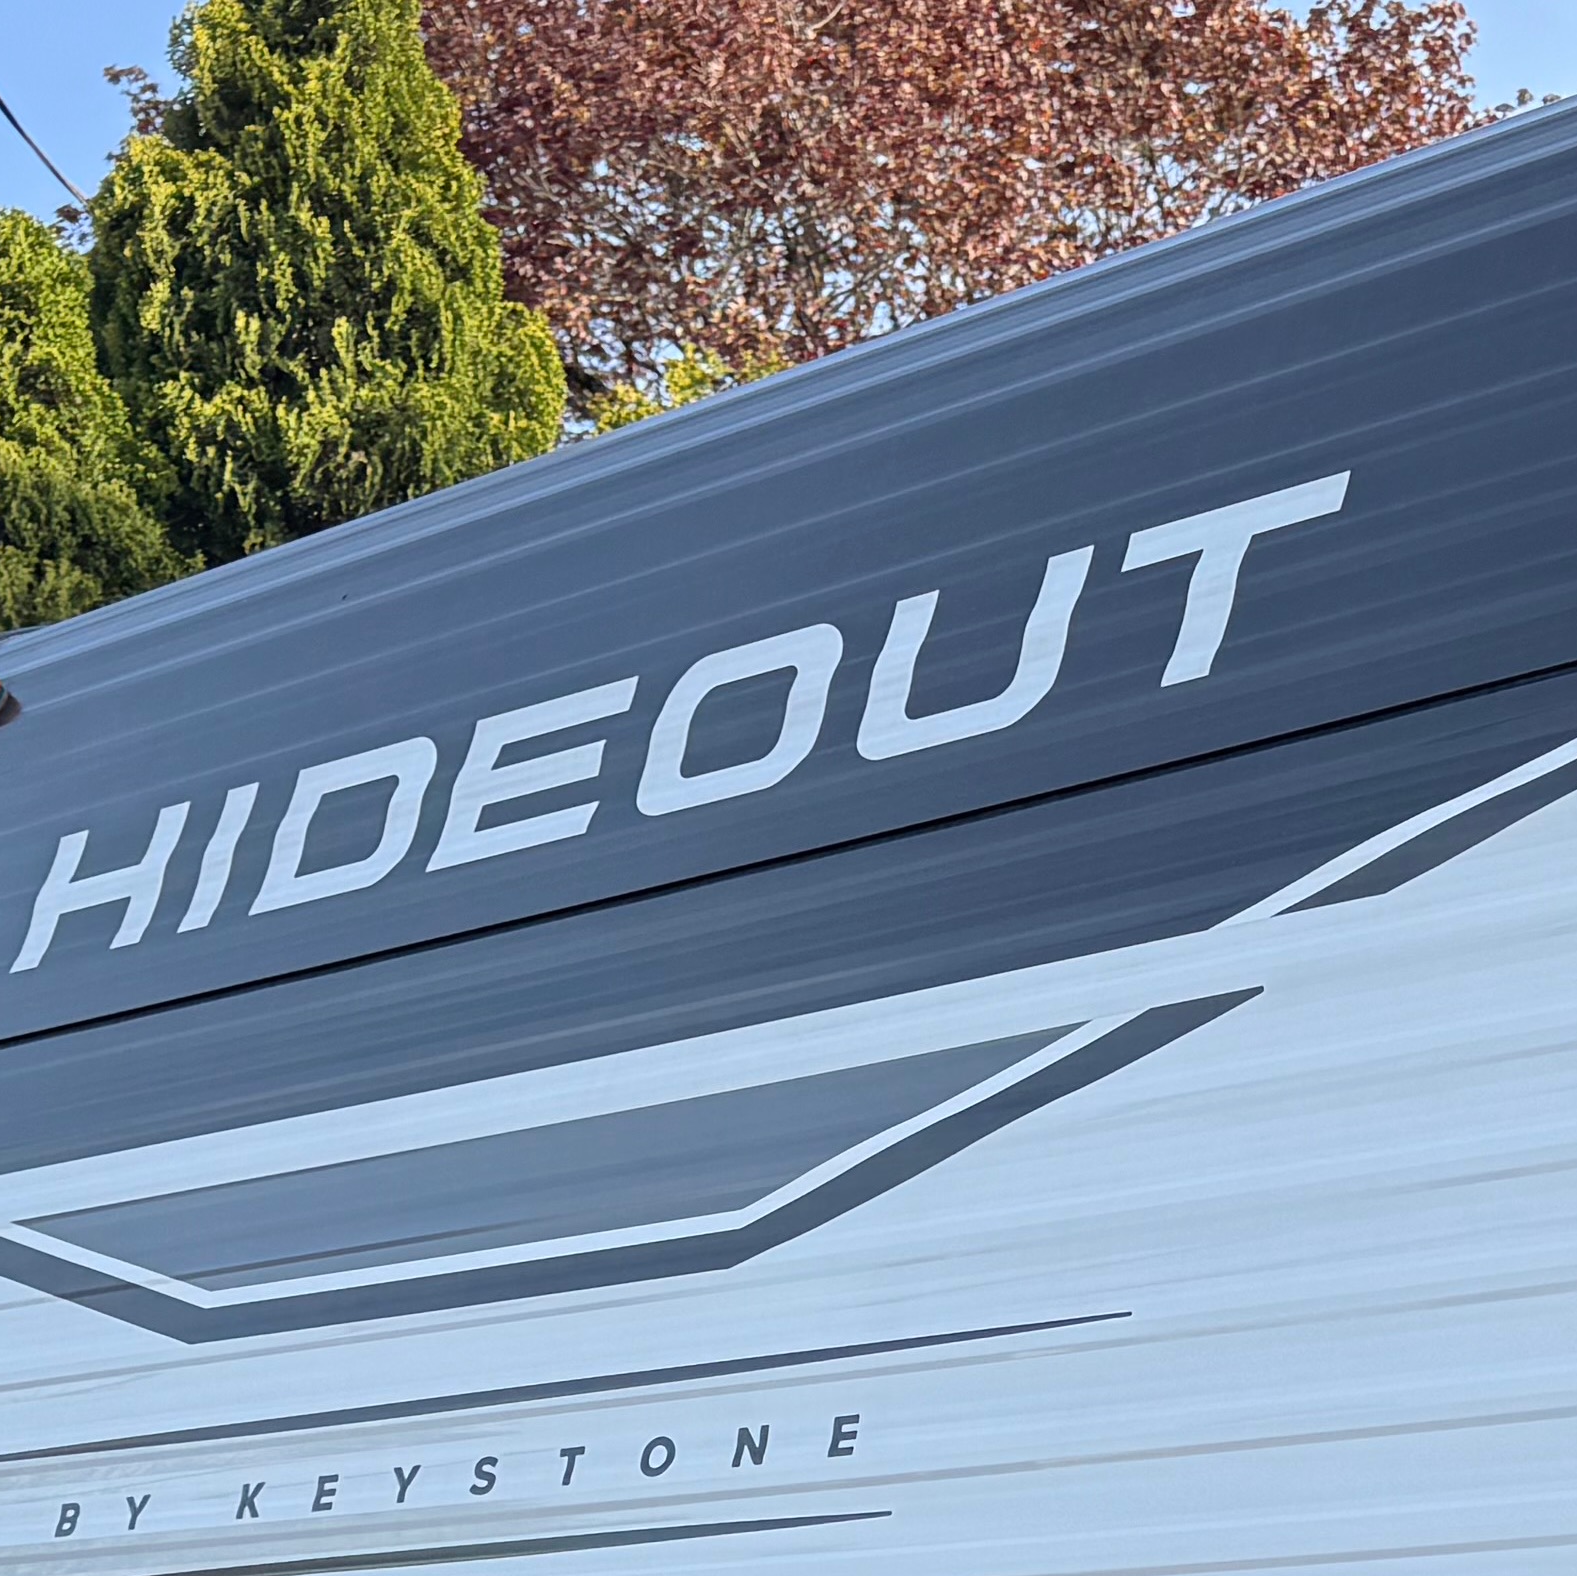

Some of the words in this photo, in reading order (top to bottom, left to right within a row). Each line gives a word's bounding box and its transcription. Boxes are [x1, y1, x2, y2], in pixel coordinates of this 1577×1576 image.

[10, 471, 1350, 973] HIDEOUT
[55, 1494, 151, 1537] BY
[236, 1414, 860, 1519] KEYSTONE
